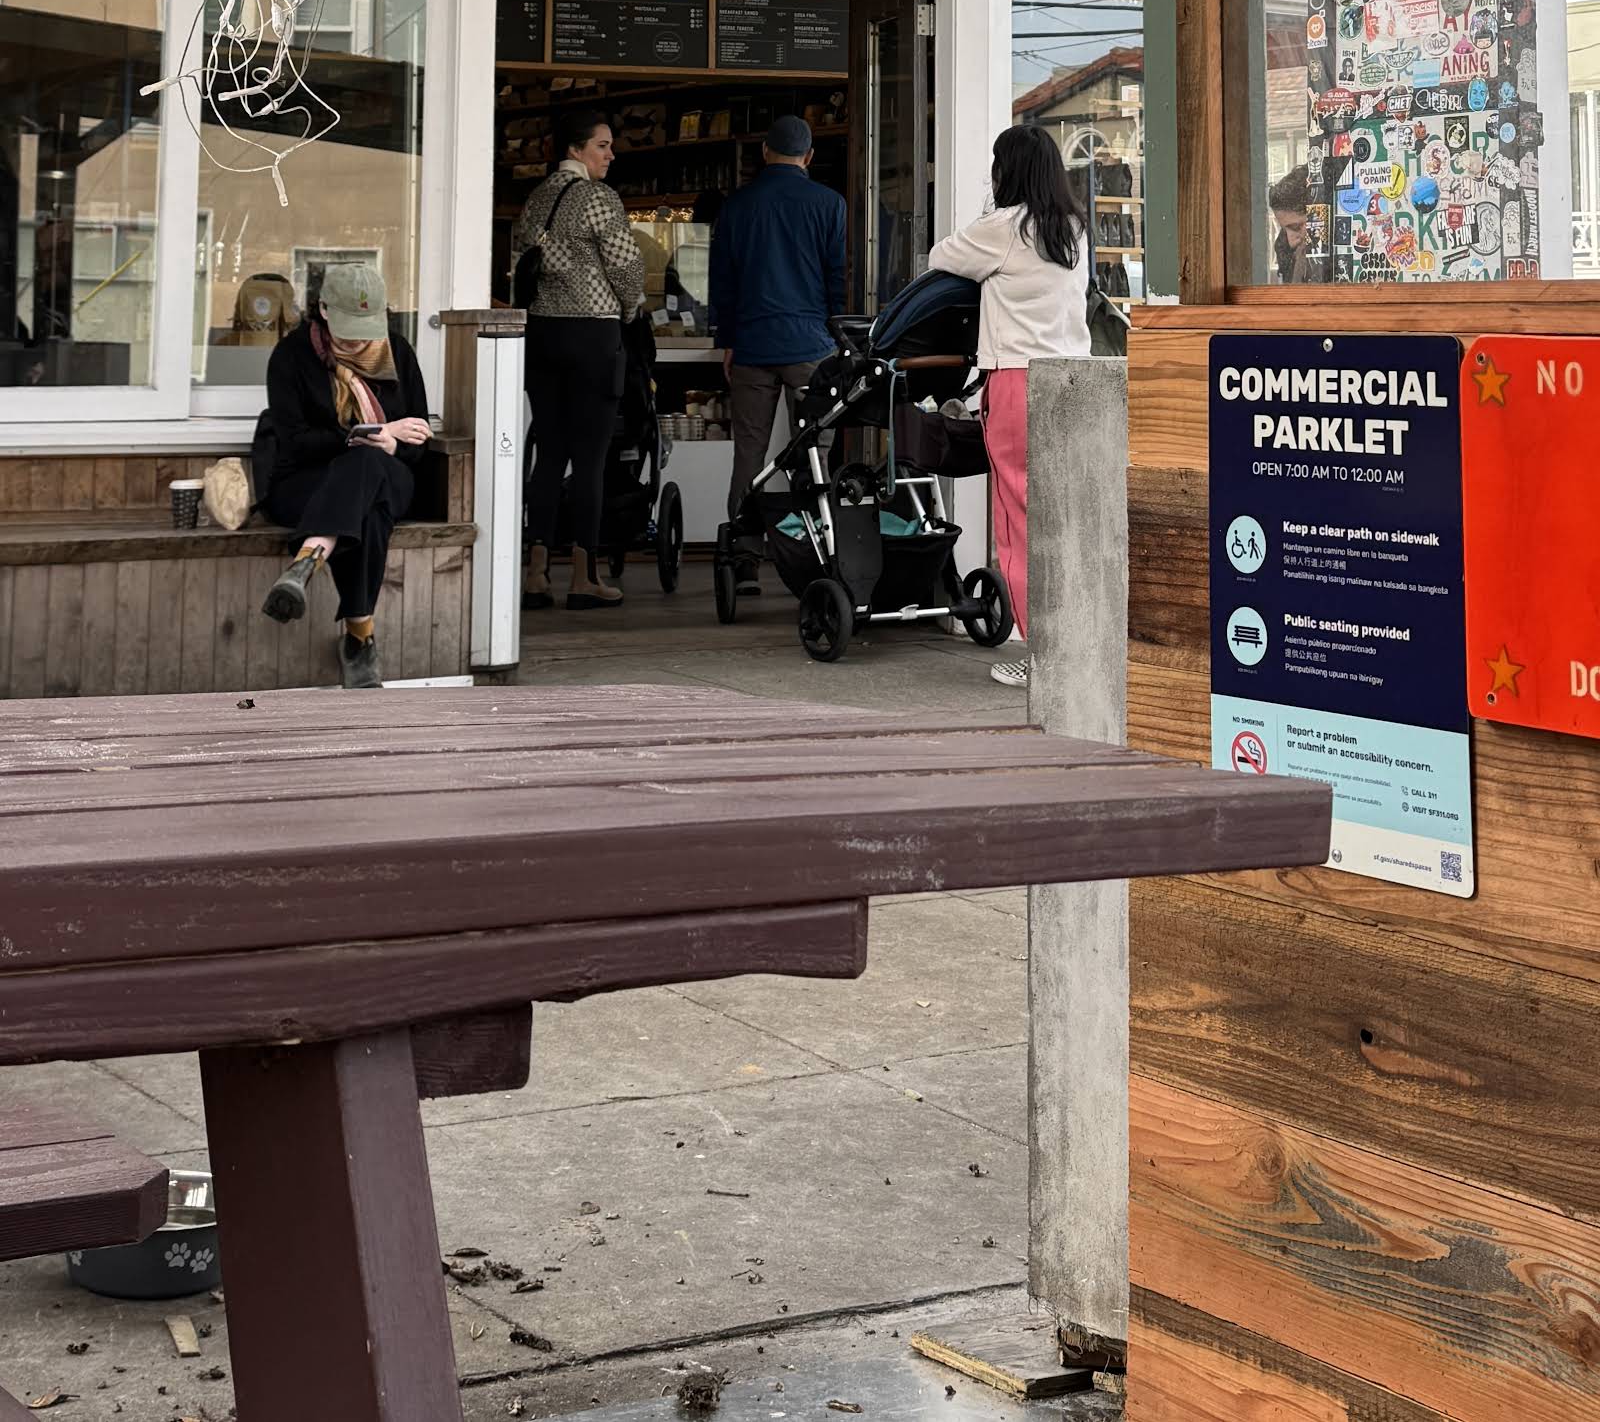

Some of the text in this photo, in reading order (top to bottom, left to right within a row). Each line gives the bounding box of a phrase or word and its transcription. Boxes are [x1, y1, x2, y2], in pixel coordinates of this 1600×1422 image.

[1388, 97, 1411, 110] CHET
[1360, 166, 1391, 177] PULLING
[1370, 199, 1377, 211] 3
[1455, 225, 1473, 246] FUN
[1219, 367, 1448, 407] COMMERCIAL
[1537, 360, 1583, 396] NO
[1253, 414, 1409, 456] PARKLET
[1252, 461, 1404, 484] OPEN 7:00 AM TO 12:00 AM
[1283, 521, 1440, 546] Keep a clear path on sidewalk
[1283, 542, 1313, 554] Mantenga
[1378, 551, 1409, 562] banqueta
[1315, 575, 1328, 584] ang
[1328, 575, 1346, 585] isang
[1417, 584, 1449, 596] bangketa
[1284, 613, 1410, 641] Public seating provided
[1349, 673, 1358, 681] na
[1241, 717, 1265, 727] SMOKING
[1286, 724, 1358, 745] Report a problem
[1287, 740, 1434, 773] or submit an accessibility concern.
[1411, 788, 1427, 798] CALL
[1412, 805, 1459, 821] VISIT SF311.ORG
